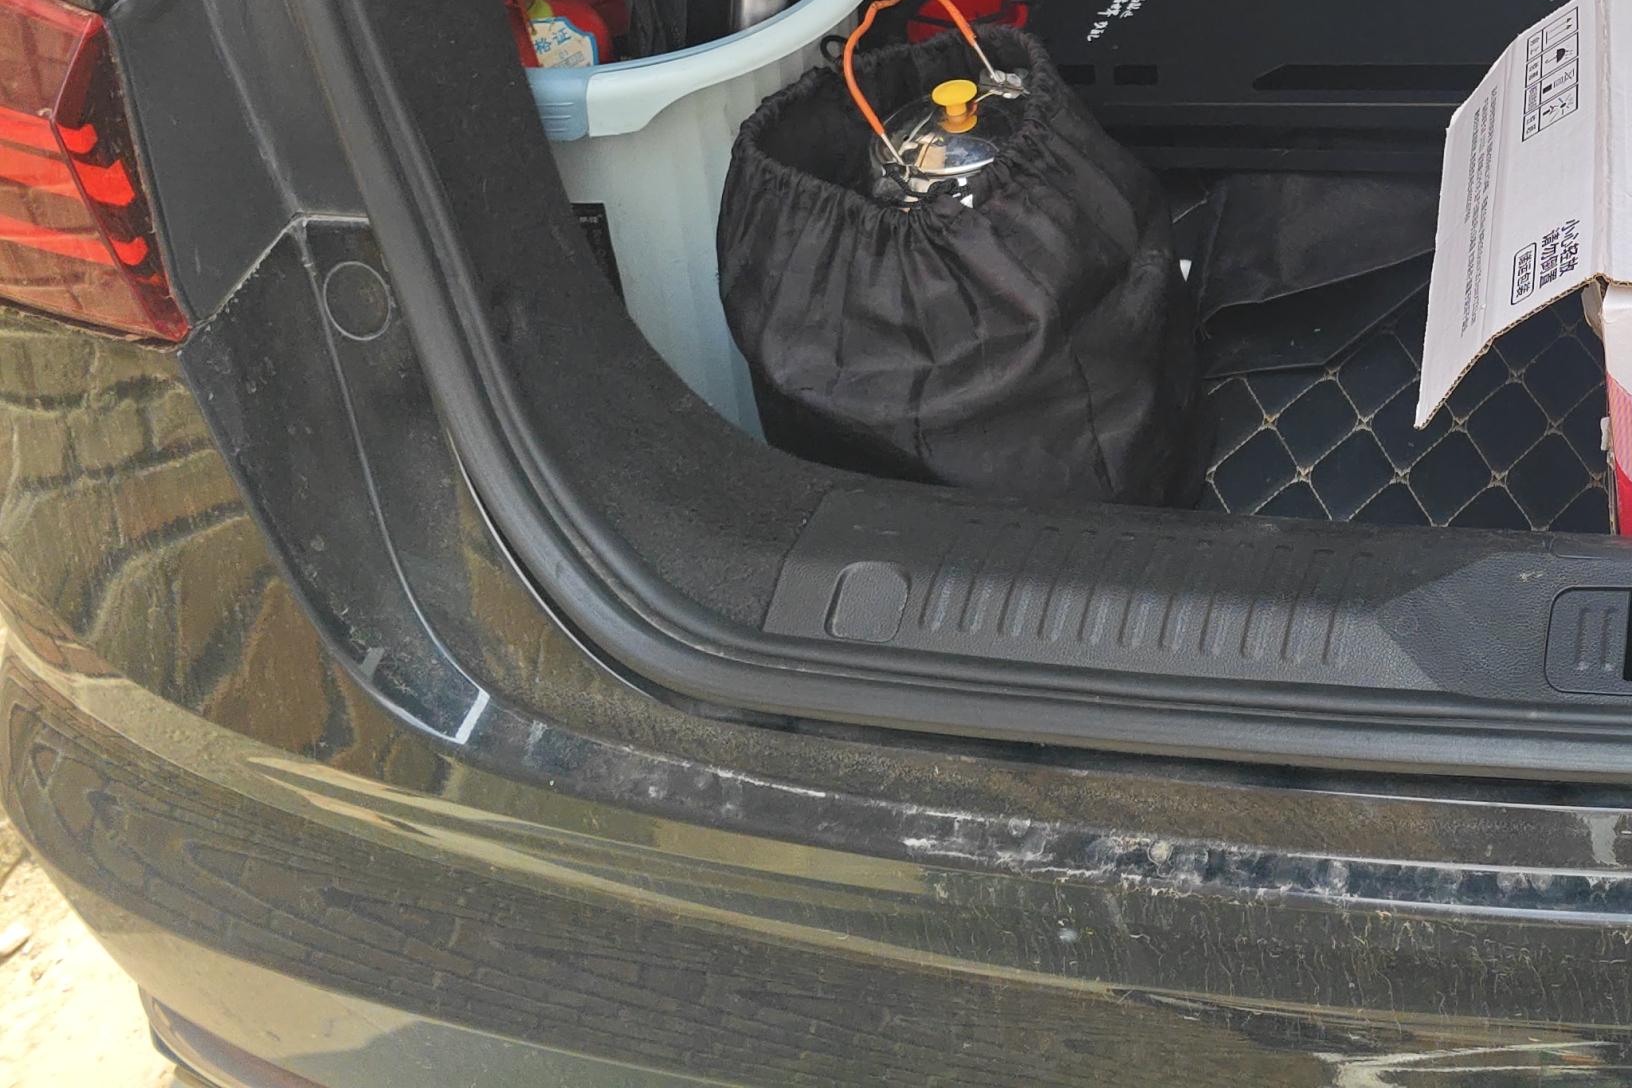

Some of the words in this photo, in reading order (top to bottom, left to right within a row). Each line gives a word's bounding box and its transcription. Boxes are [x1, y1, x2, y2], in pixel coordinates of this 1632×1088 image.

[535, 27, 571, 55] 格证
[1539, 226, 1560, 289] 请勿倒置
[1560, 218, 1580, 278] 小心轻放
